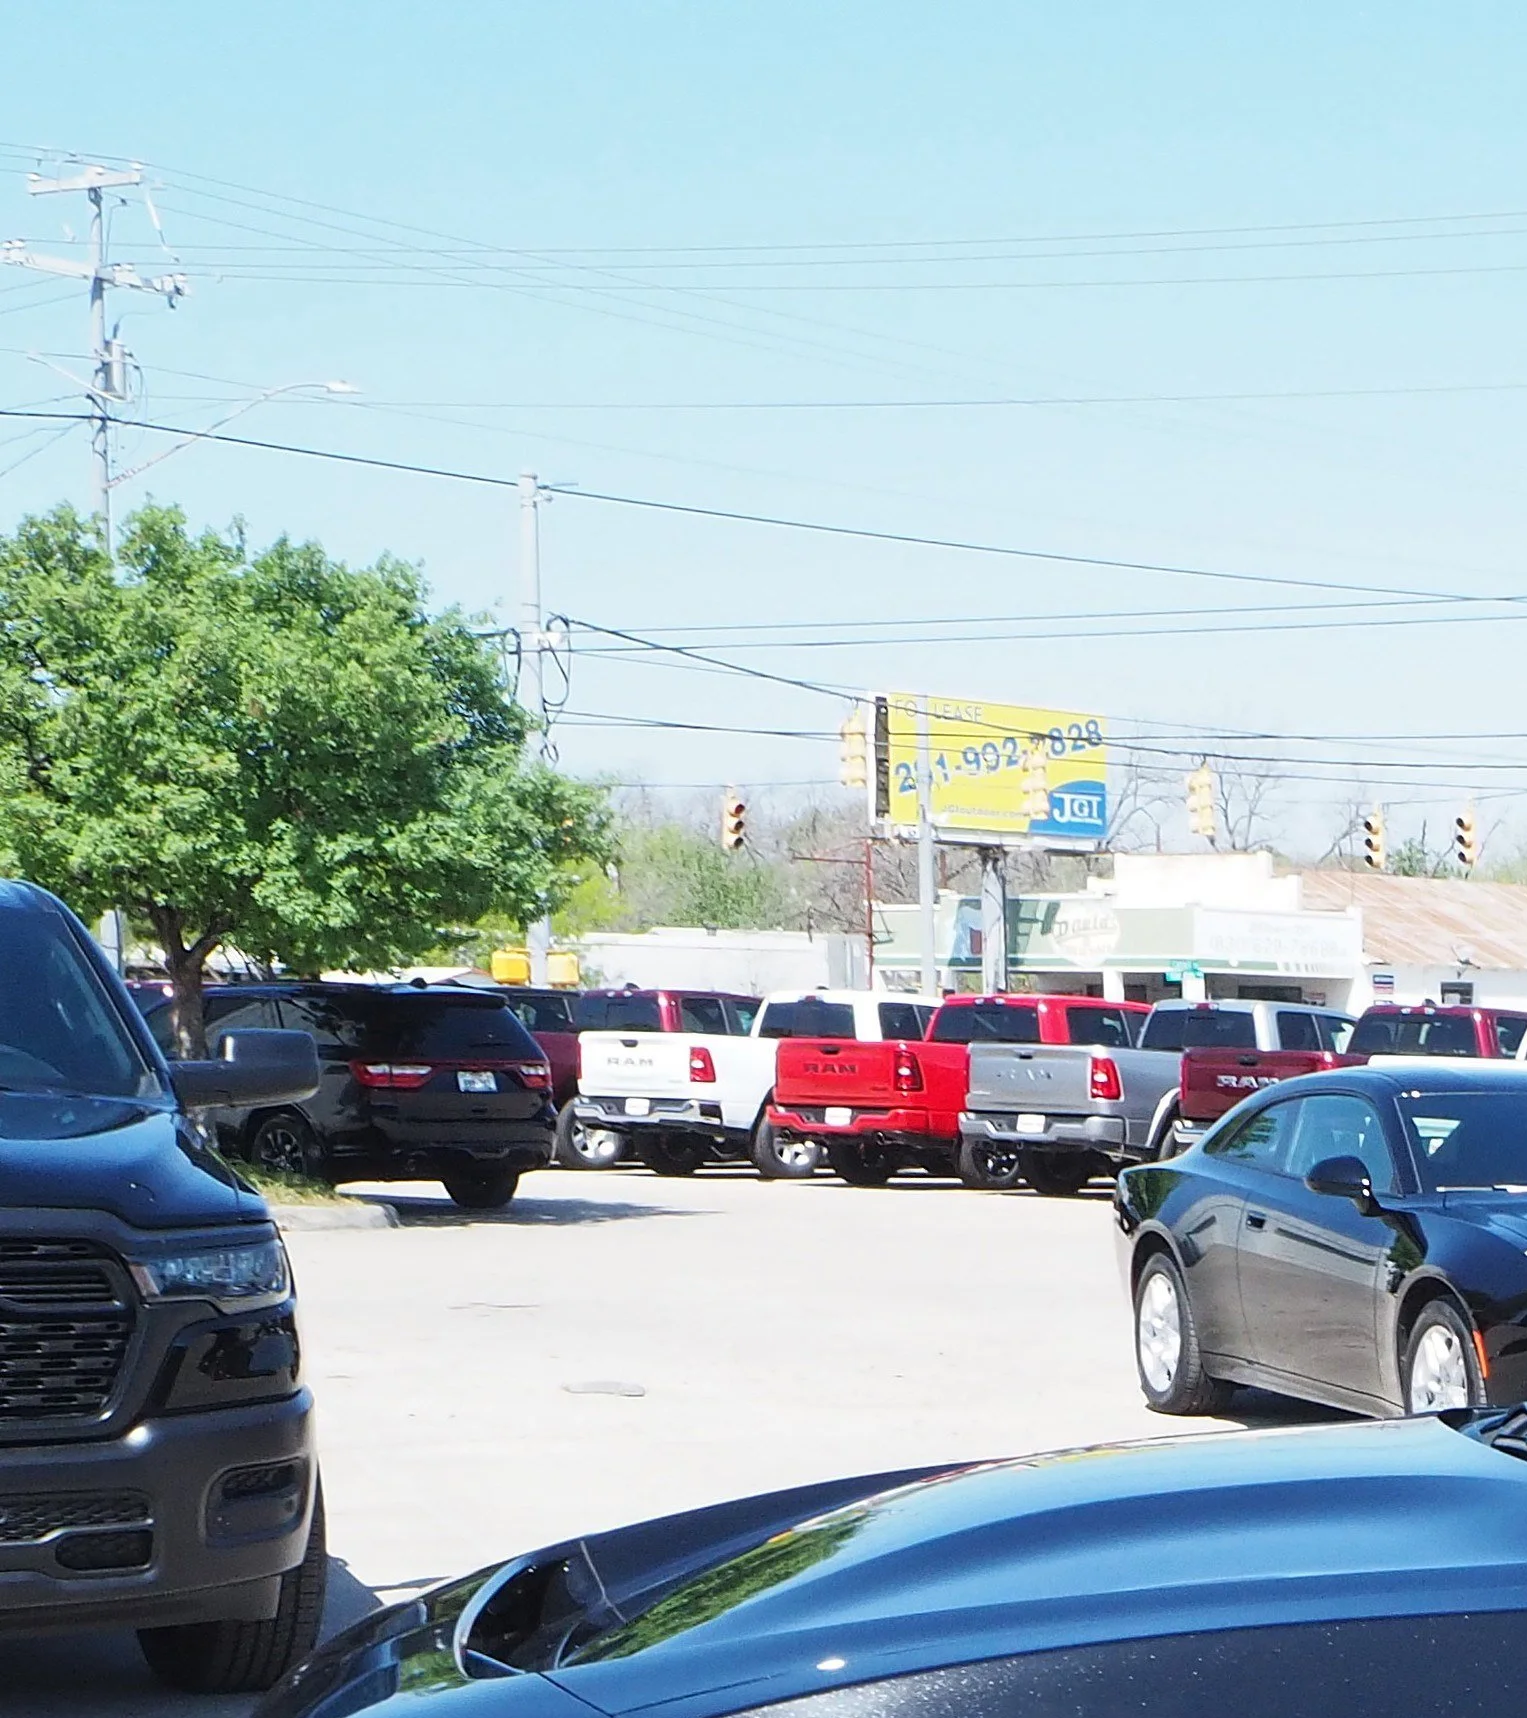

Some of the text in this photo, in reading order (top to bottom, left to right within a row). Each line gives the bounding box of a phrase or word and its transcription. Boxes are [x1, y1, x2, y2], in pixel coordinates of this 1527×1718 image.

[934, 702, 983, 723] LEASE
[1052, 792, 1103, 826] JGI
[606, 1056, 654, 1067] RAM
[803, 1063, 858, 1075] RAM
